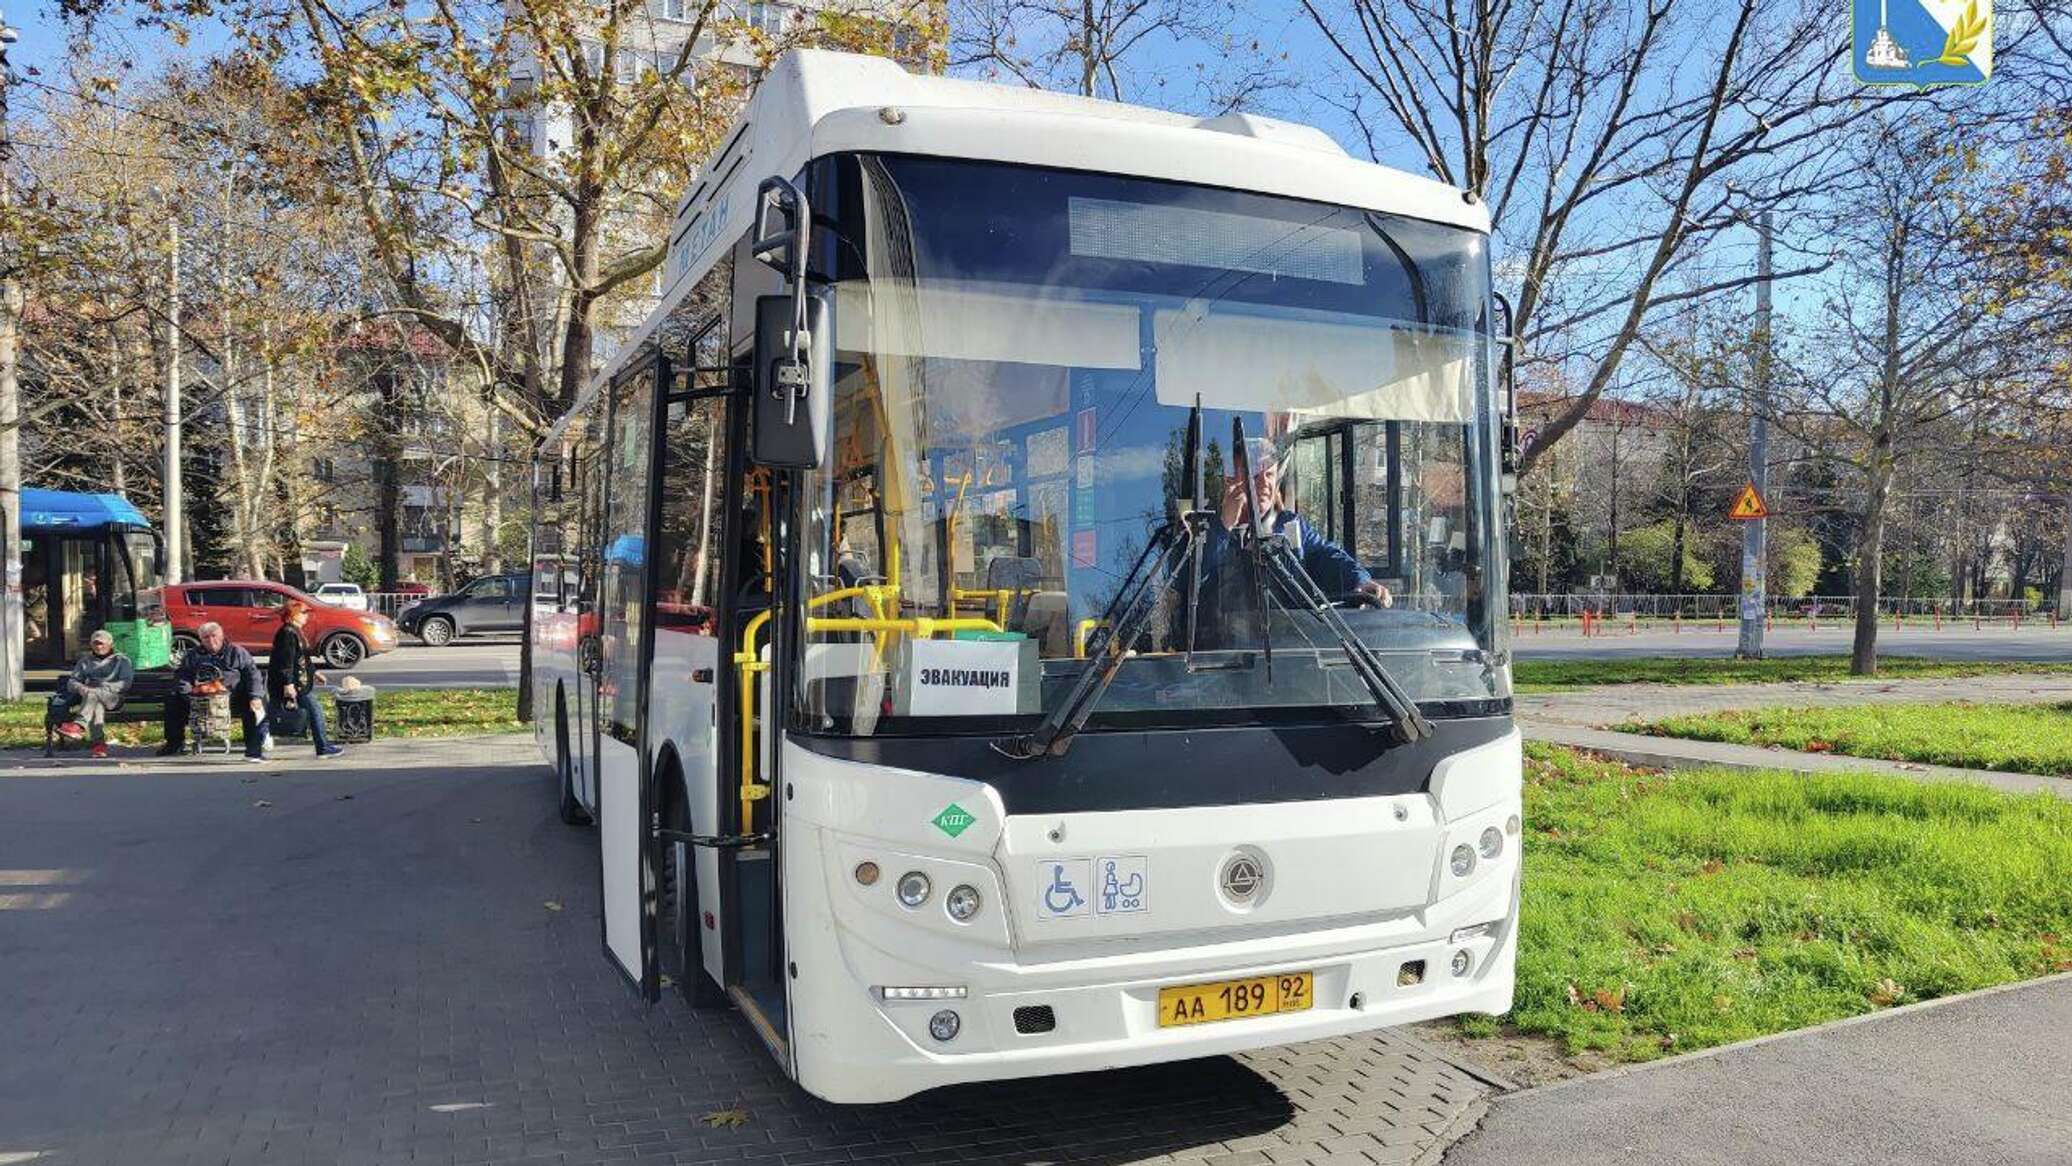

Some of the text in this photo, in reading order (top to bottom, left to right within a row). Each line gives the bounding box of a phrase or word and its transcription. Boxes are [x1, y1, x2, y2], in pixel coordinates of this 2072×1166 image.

[920, 669, 1010, 689] ЭВАКУАЦИЯ
[1219, 983, 1265, 1014] 189
[1281, 976, 1304, 999] 92
